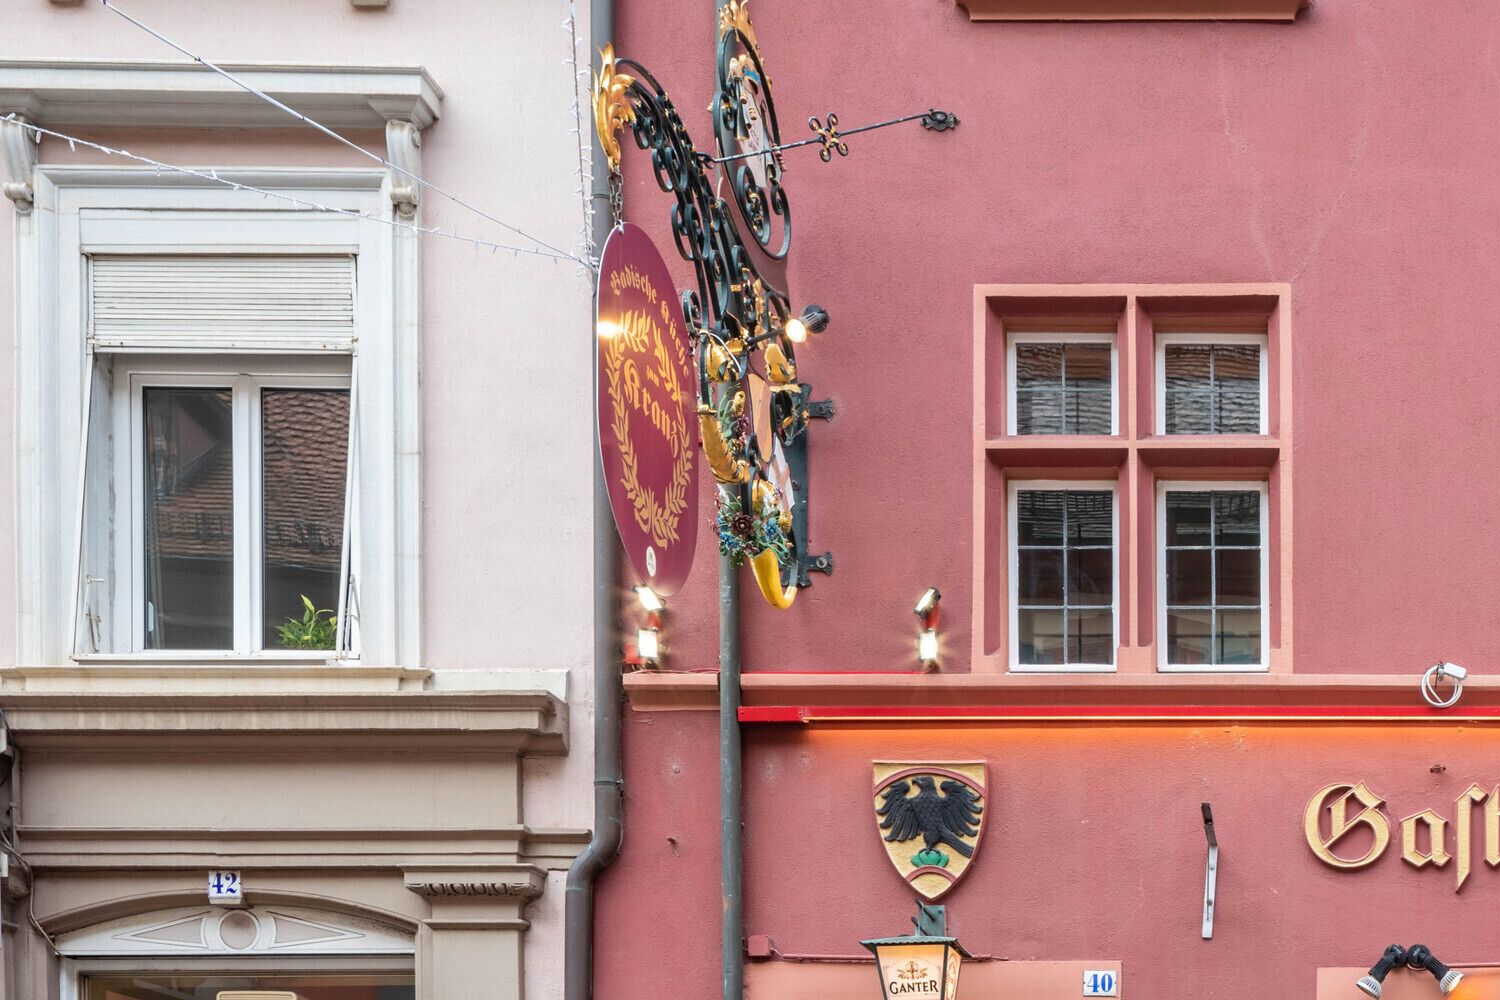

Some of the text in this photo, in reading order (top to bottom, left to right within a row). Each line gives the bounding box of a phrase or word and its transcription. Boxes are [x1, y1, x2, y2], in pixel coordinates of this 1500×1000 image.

[611, 264, 657, 304] Badische
[623, 359, 679, 458] Kranz
[212, 872, 237, 894] 42
[889, 980, 939, 995] GANTER
[1086, 973, 1113, 993] 40
